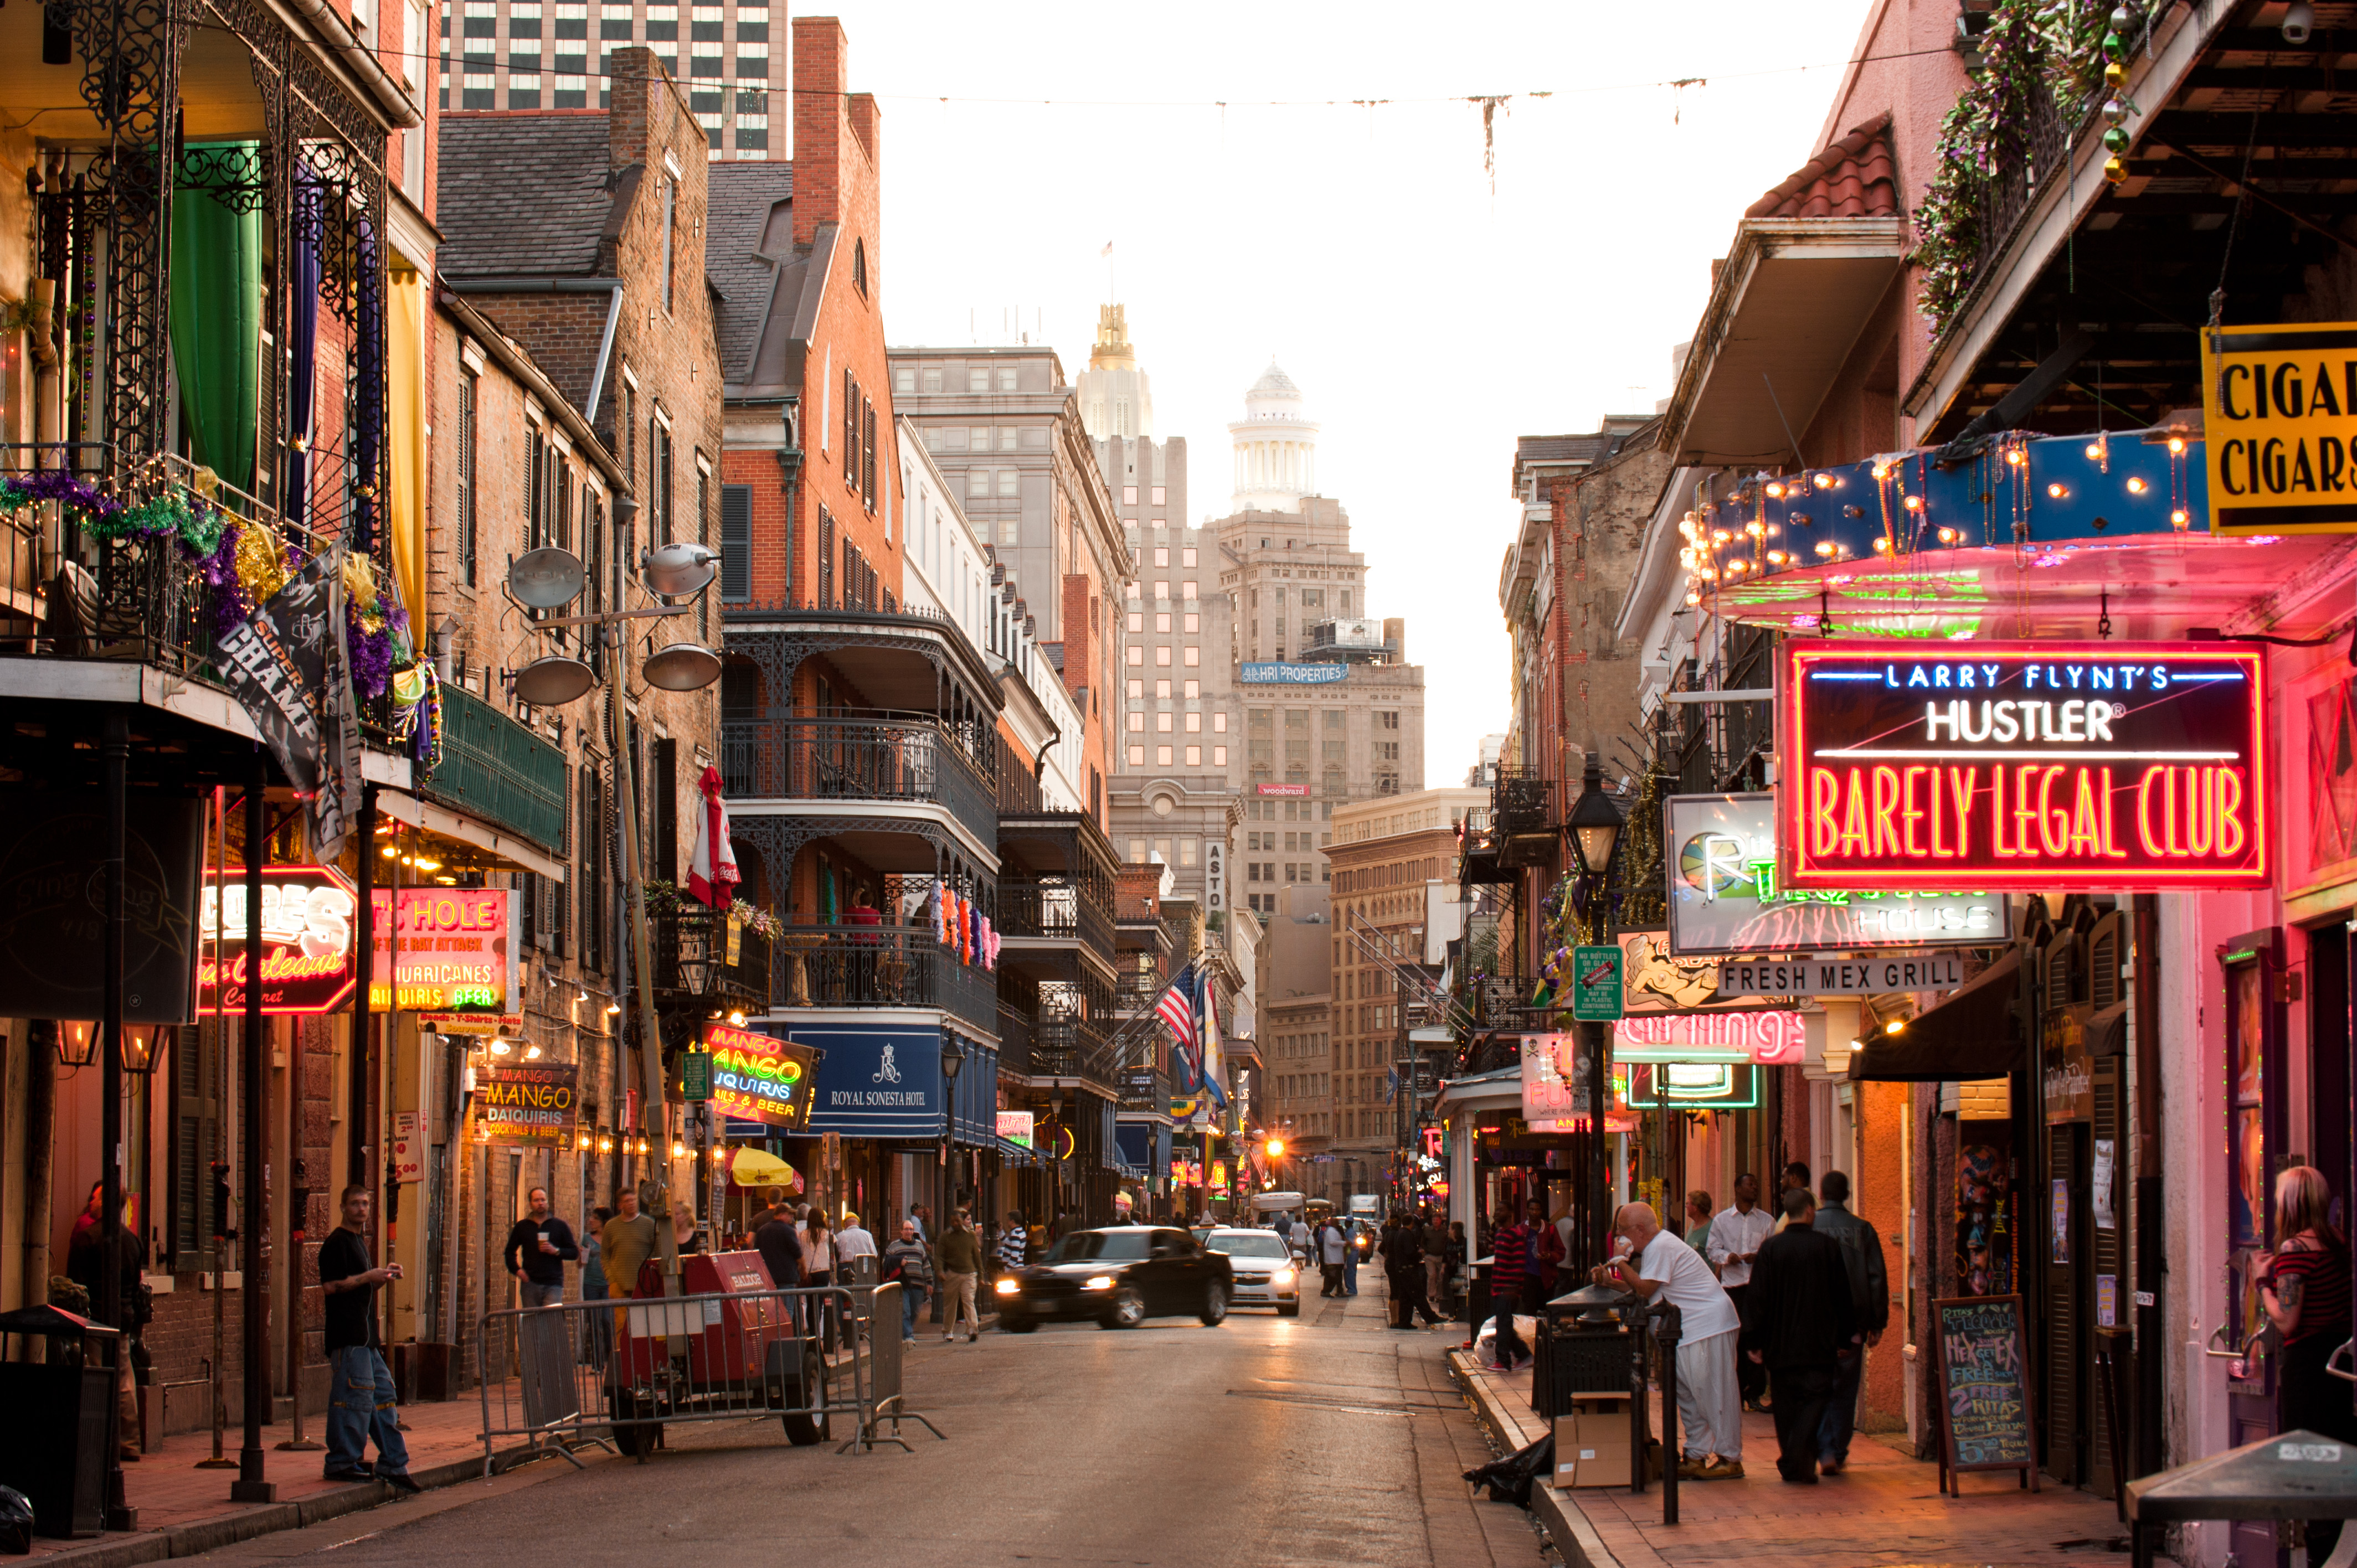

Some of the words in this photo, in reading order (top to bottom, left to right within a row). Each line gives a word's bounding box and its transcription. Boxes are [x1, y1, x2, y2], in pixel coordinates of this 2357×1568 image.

[255, 620, 303, 690] SUPER
[1260, 667, 1277, 680] HRI
[1280, 666, 1341, 682] PROPERTIES
[1885, 664, 2000, 688] LARRY
[2025, 665, 2169, 689] FLYNT'S
[340, 711, 363, 774] SAIN
[1811, 766, 1976, 858] BARELY
[1994, 765, 2127, 858] LEGAL
[2138, 766, 2244, 857] CLUB
[414, 900, 495, 932] HOLE
[1859, 905, 1989, 932] HOUSE
[409, 937, 433, 951] RAT
[435, 937, 482, 951] ATTACK
[1725, 966, 1806, 990] FRESH
[1820, 964, 1870, 989] MEX
[1885, 960, 1958, 987] GRILL
[453, 989, 493, 1007] BEER
[420, 1013, 450, 1022] Beads
[455, 1014, 493, 1024] T-Shirts
[498, 1015, 522, 1024] Hats
[445, 1024, 495, 1034] Souvenirs
[710, 1028, 781, 1055] MANGO
[502, 1069, 553, 1084] MANGO
[486, 1082, 570, 1108] MANGO
[831, 1091, 865, 1106] ROYAL
[866, 1091, 904, 1106] SONESTA
[905, 1091, 926, 1106] HOTEL
[712, 1099, 760, 1122] IZZA
[741, 1096, 750, 1107] &
[756, 1098, 795, 1117] BEER
[488, 1108, 563, 1125] DAIQUIRIS
[490, 1123, 529, 1136] COCKTAILS
[532, 1126, 537, 1135] &
[540, 1126, 559, 1137] BEER
[731, 1273, 763, 1287] BALDOR
[1975, 1348, 1995, 1358] GET
[1951, 1367, 1994, 1383] FREE
[1949, 1389, 1973, 1416] 2
[1969, 1385, 2011, 1400] FREE
